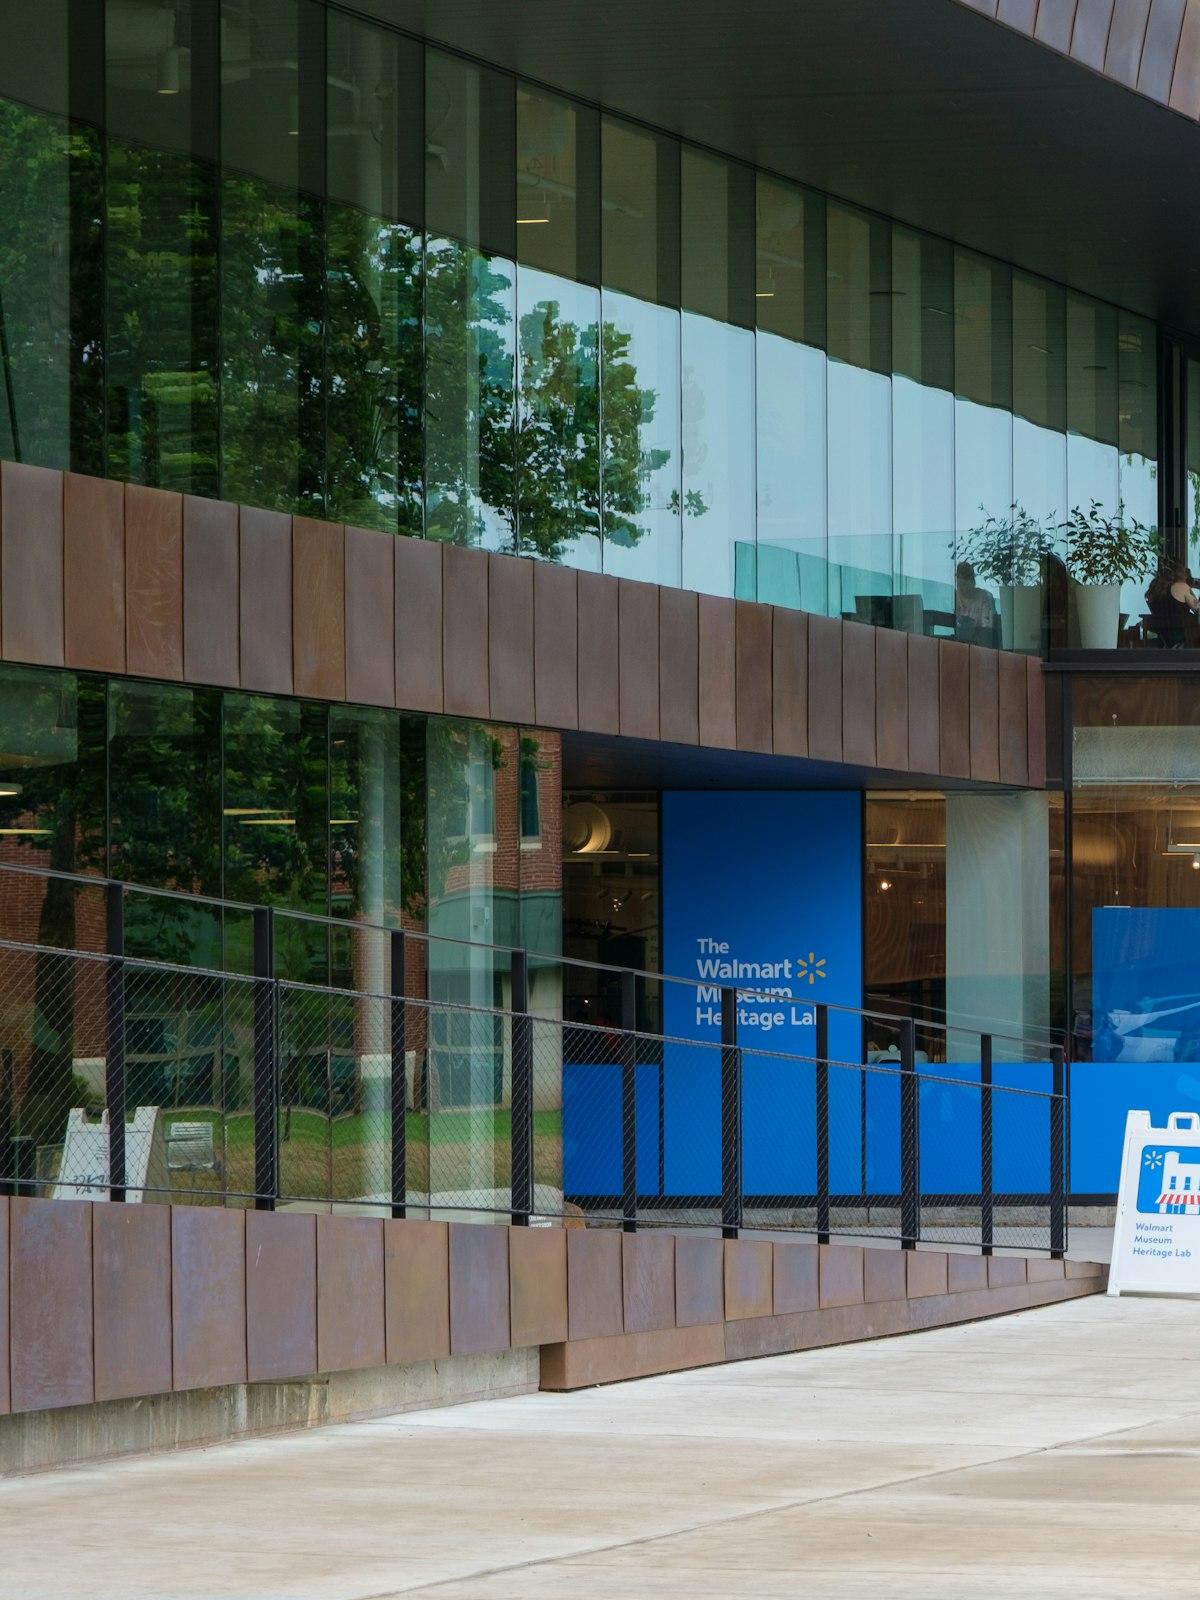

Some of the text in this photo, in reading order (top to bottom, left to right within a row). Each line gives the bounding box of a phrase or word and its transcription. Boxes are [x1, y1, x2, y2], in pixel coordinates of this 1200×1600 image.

[696, 938, 730, 954] The
[696, 959, 792, 979] Walmart
[696, 985, 793, 1003] Mseum
[696, 1007, 817, 1031] Heitage La
[1135, 1222, 1174, 1232] Walmart
[1134, 1235, 1172, 1244] Museum
[1132, 1247, 1192, 1258] Heritage Lab
